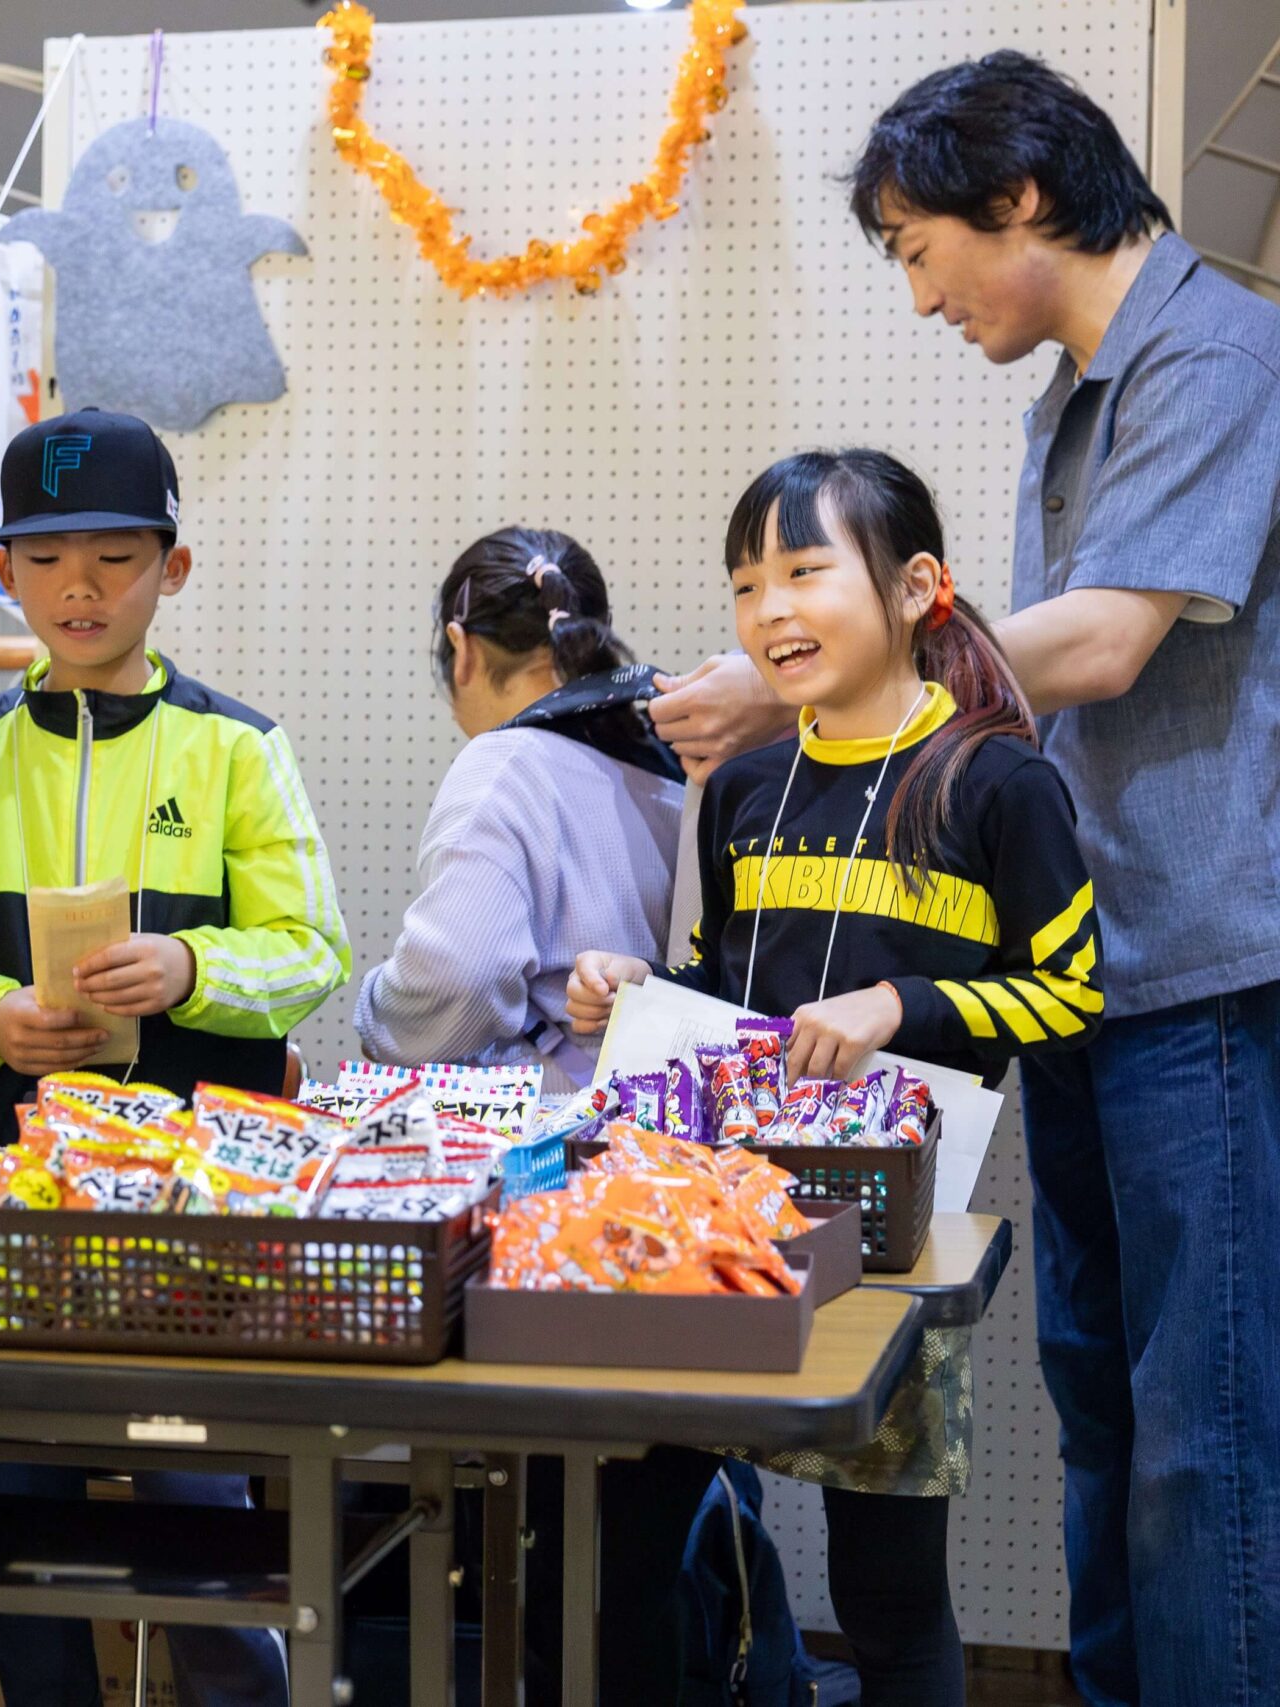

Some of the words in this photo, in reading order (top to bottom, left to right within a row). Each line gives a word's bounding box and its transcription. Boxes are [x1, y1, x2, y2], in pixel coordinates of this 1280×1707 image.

[42, 434, 92, 498] F
[147, 820, 192, 838] didas
[734, 856, 999, 946] KBUNN
[204, 1111, 330, 1158] ベビースター
